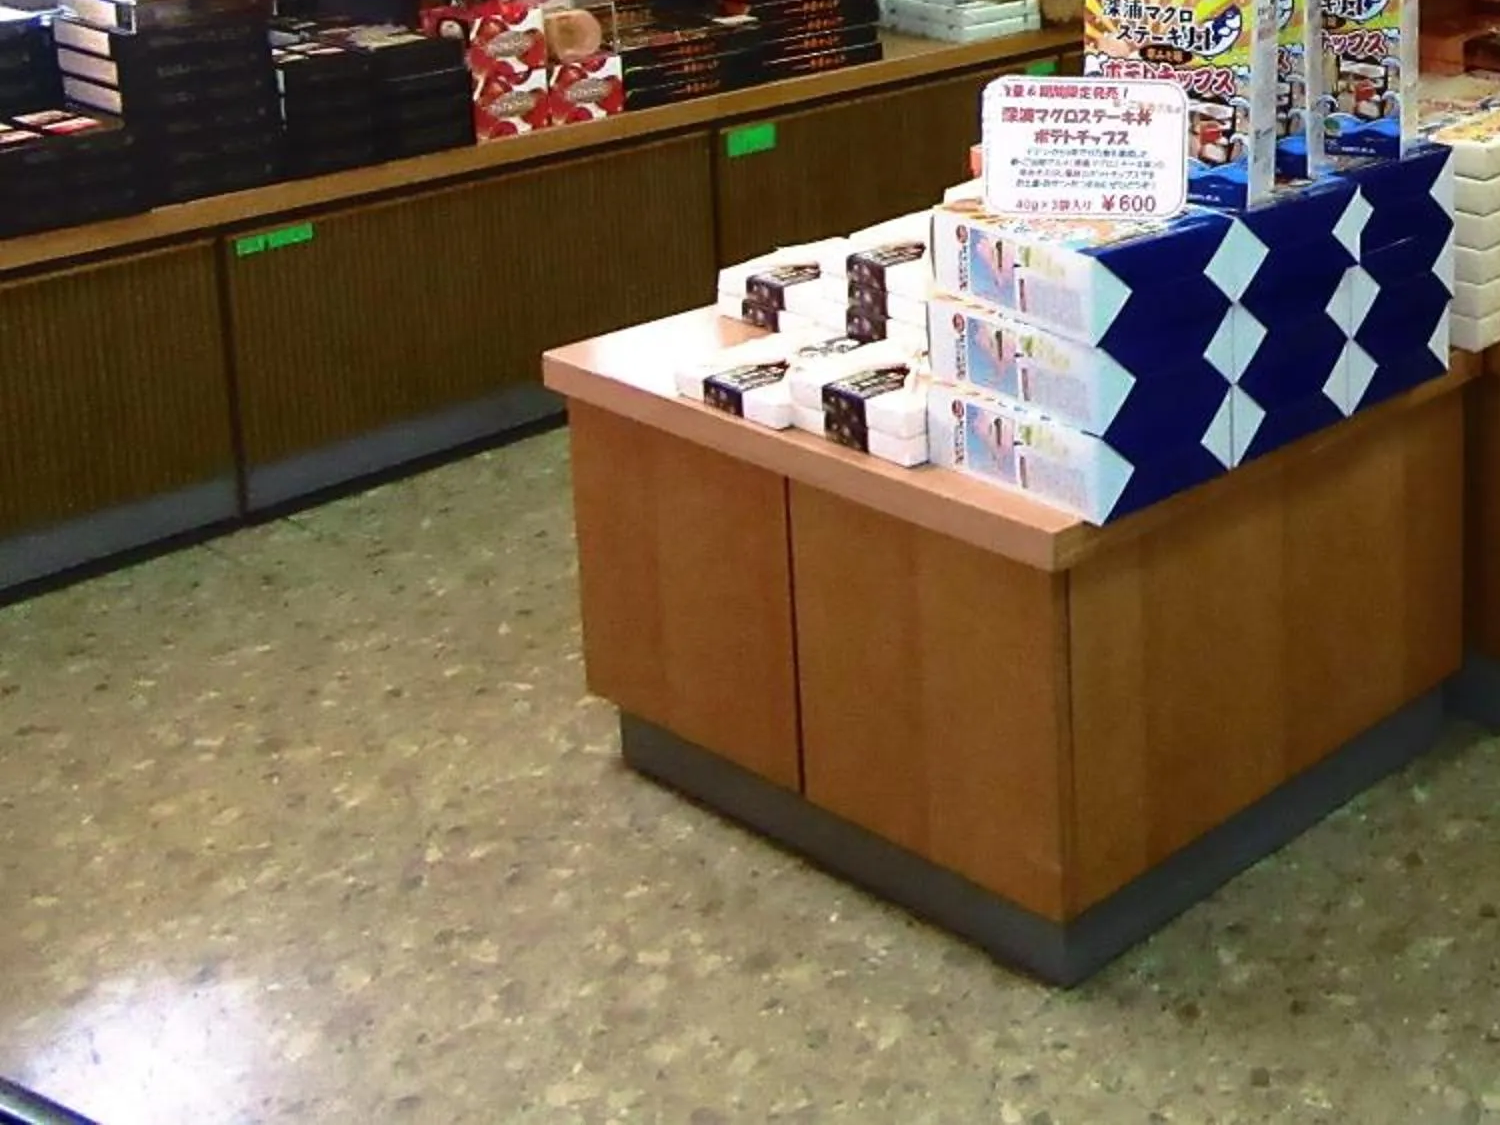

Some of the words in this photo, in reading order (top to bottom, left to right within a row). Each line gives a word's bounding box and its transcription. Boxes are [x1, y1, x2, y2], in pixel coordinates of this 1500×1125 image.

[1034, 130, 1129, 146] ポテトチップス
[1101, 194, 1157, 213] ¥600
